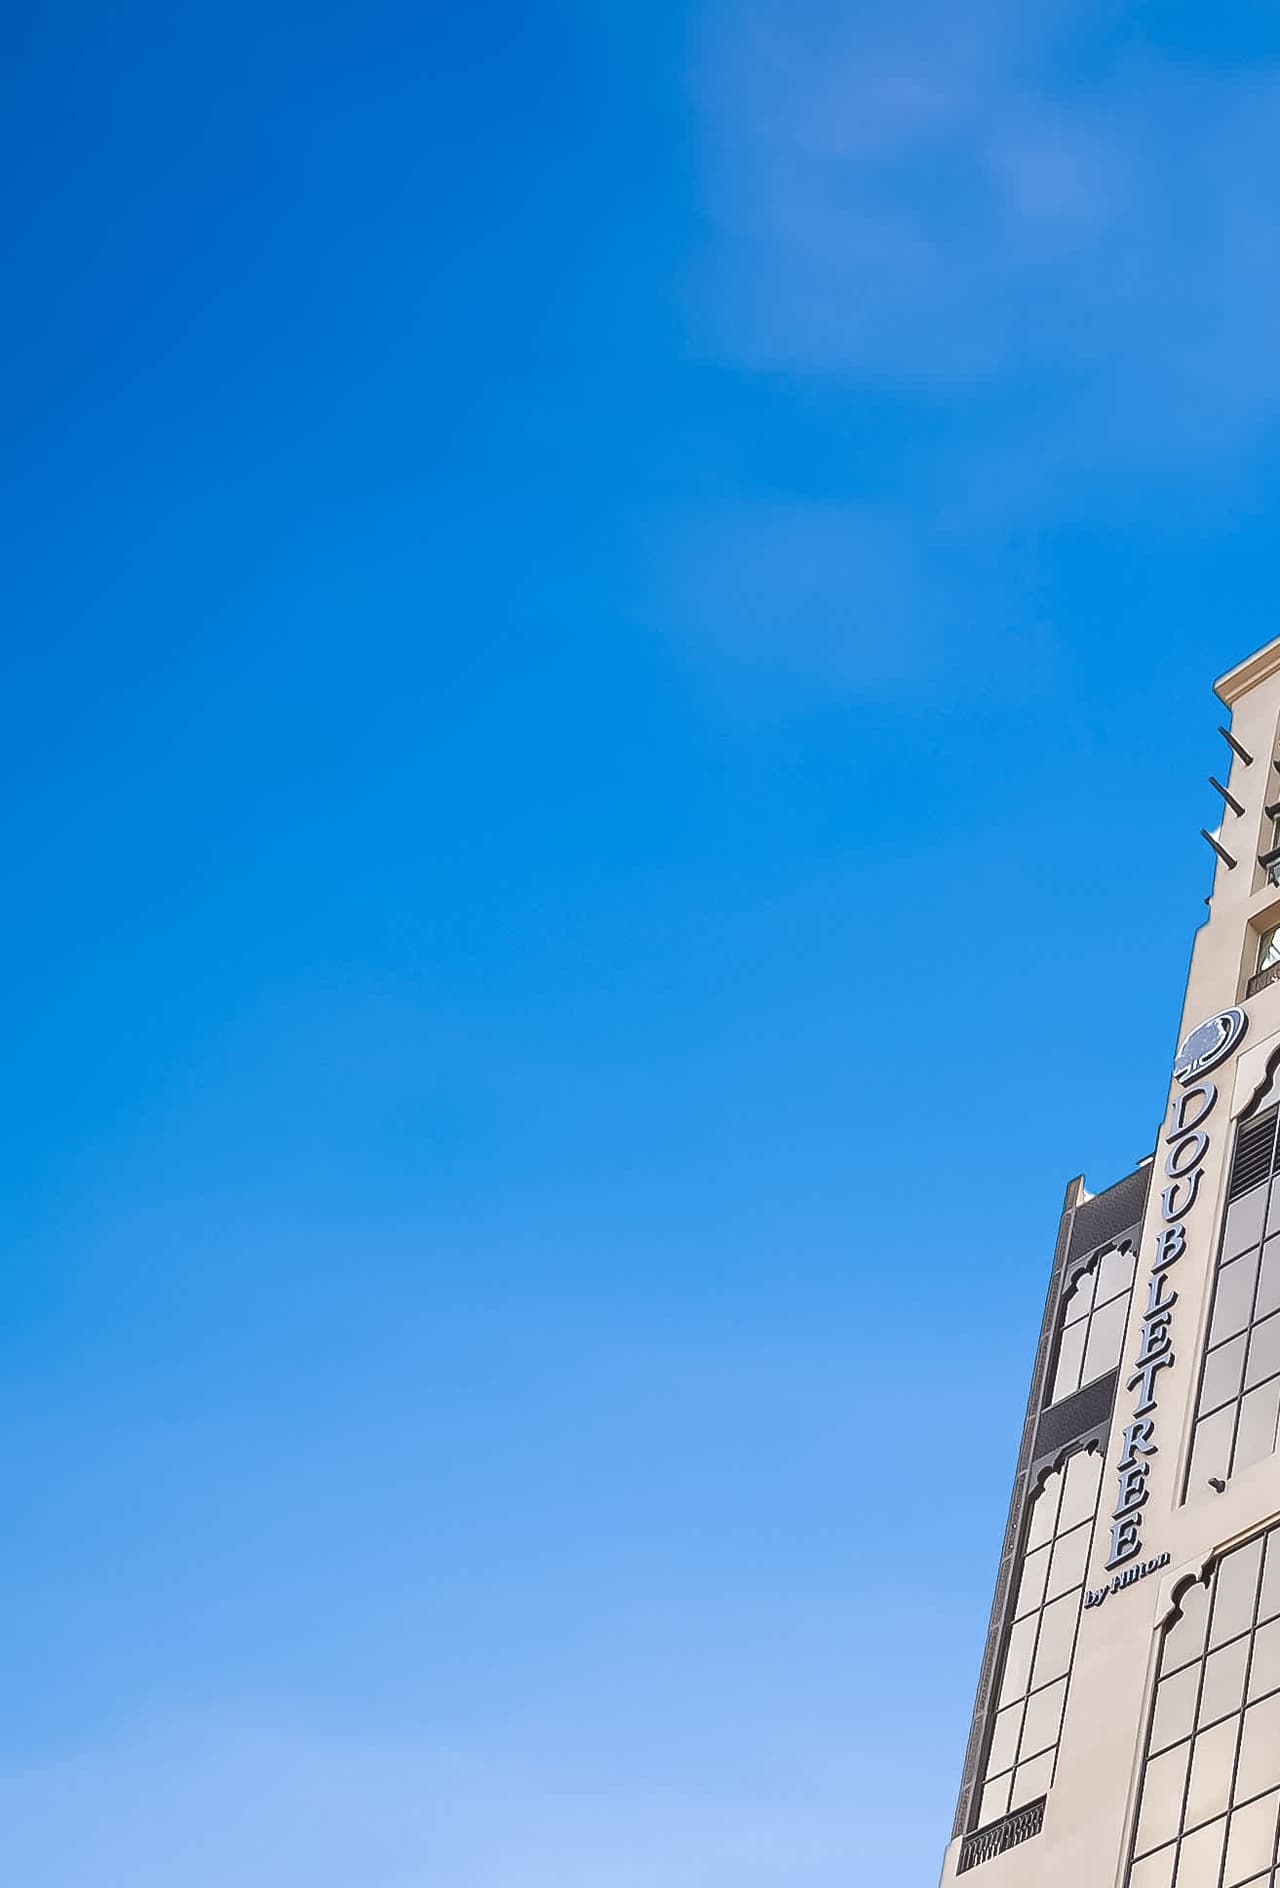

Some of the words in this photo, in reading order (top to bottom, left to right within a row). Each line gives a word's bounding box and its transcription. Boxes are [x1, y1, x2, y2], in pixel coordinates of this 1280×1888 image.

[1104, 1082, 1218, 1573] DOUBLETREE
[1084, 1585, 1110, 1610] by
[1110, 1551, 1171, 1596] Hilton
